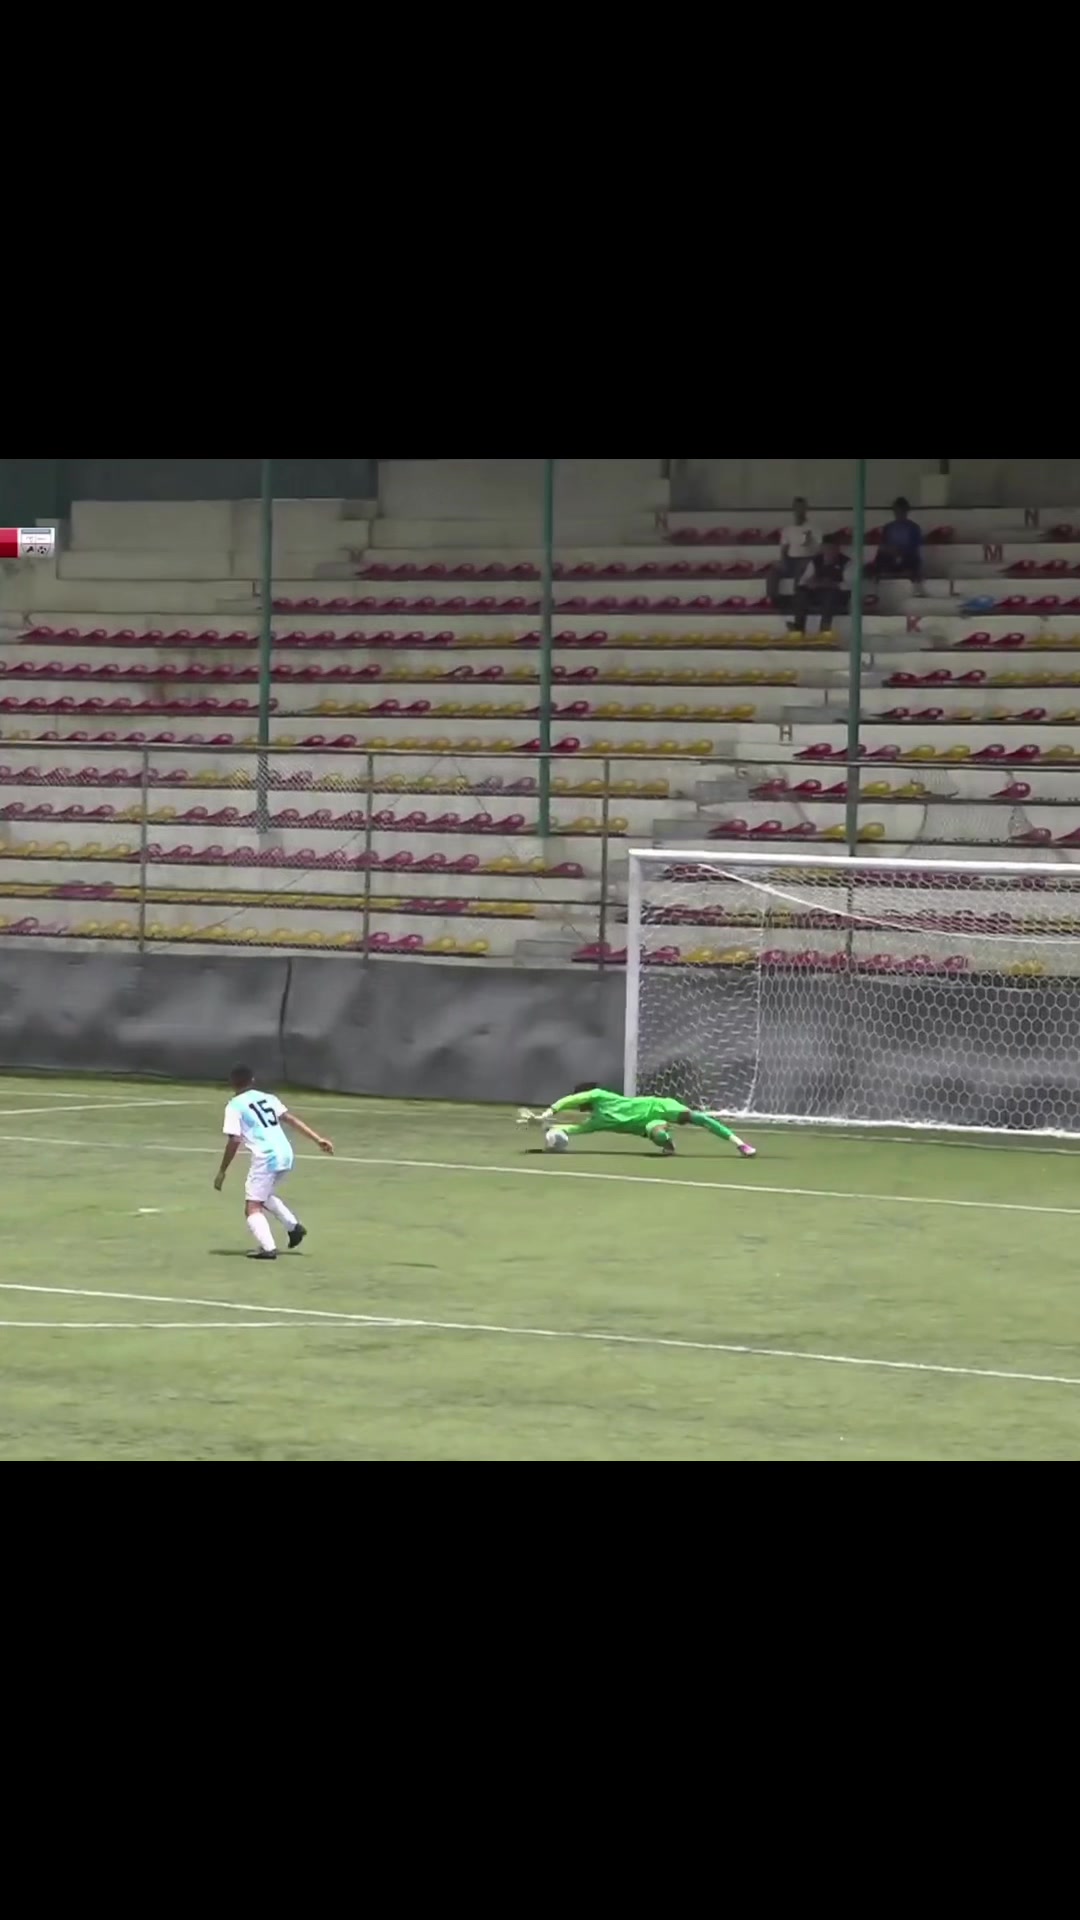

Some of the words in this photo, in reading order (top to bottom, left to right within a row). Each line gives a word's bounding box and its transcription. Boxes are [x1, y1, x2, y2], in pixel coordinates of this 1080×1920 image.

[1025, 508, 1039, 527] N
[983, 544, 1003, 562] M
[949, 580, 960, 597] L
[906, 615, 922, 633] K
[780, 723, 793, 741] H
[249, 1099, 278, 1128] 15
